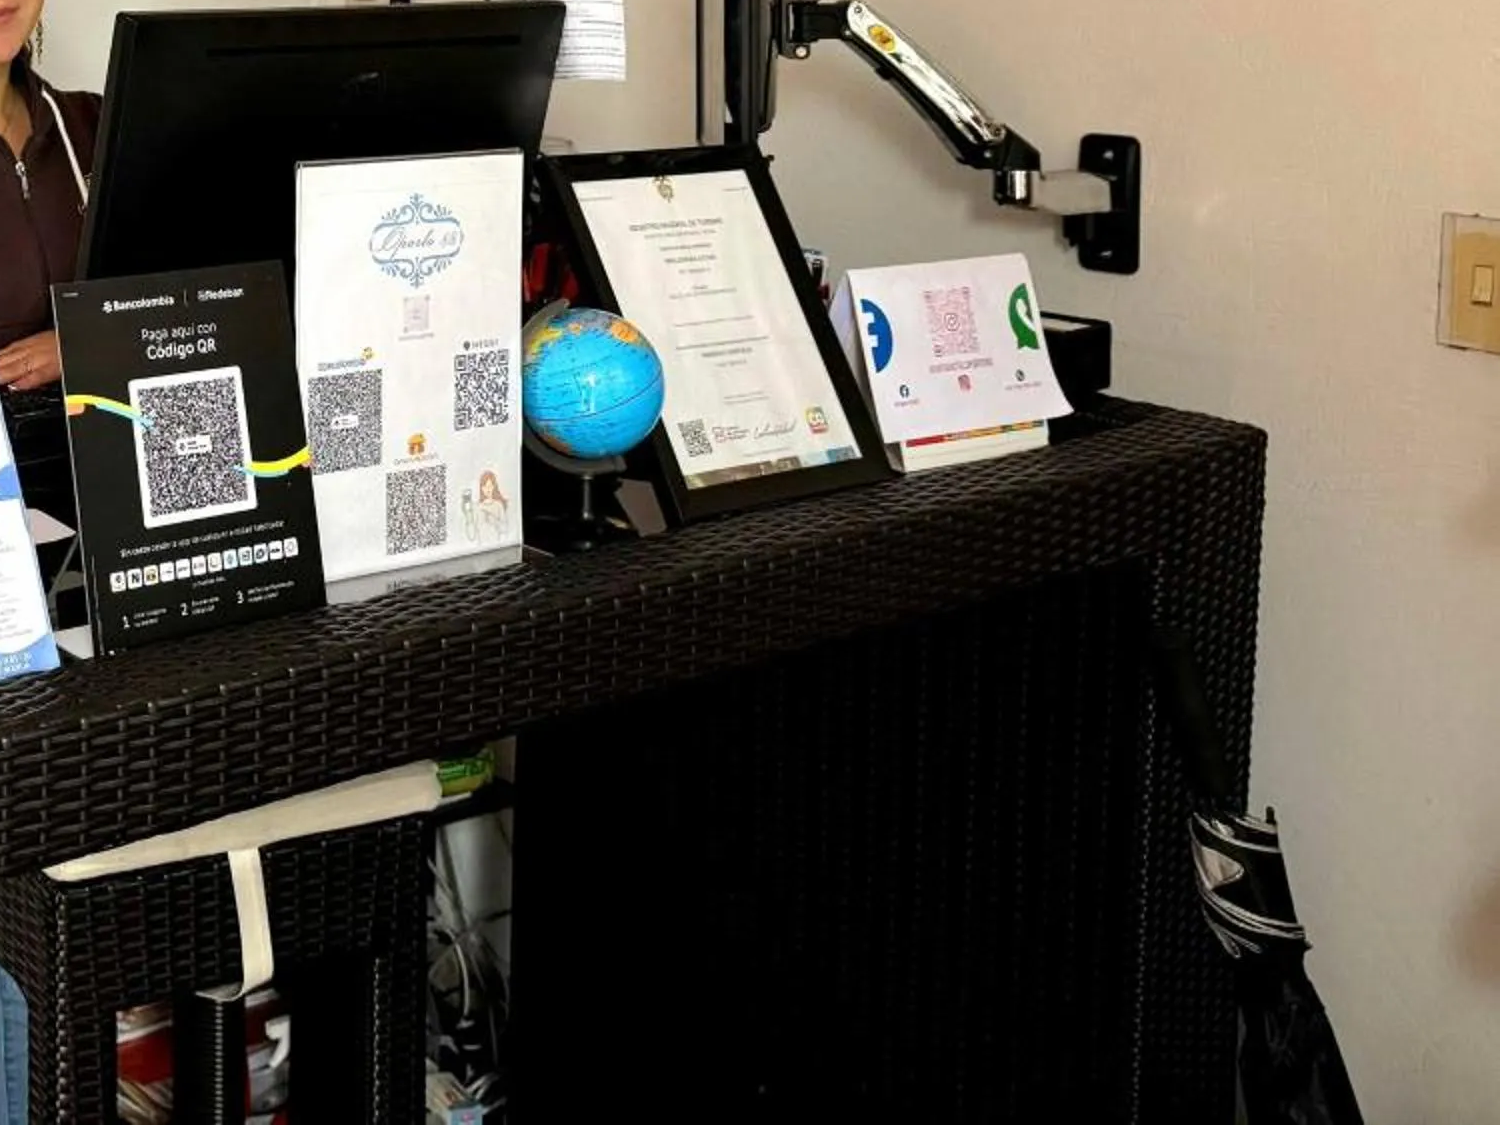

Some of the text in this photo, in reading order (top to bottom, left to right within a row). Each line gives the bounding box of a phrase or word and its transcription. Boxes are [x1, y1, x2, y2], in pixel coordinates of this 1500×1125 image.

[113, 295, 175, 311] Bancolombia
[141, 327, 169, 344] Paga
[197, 321, 218, 334] con
[146, 337, 217, 360] Código QR
[180, 602, 189, 616] 2
